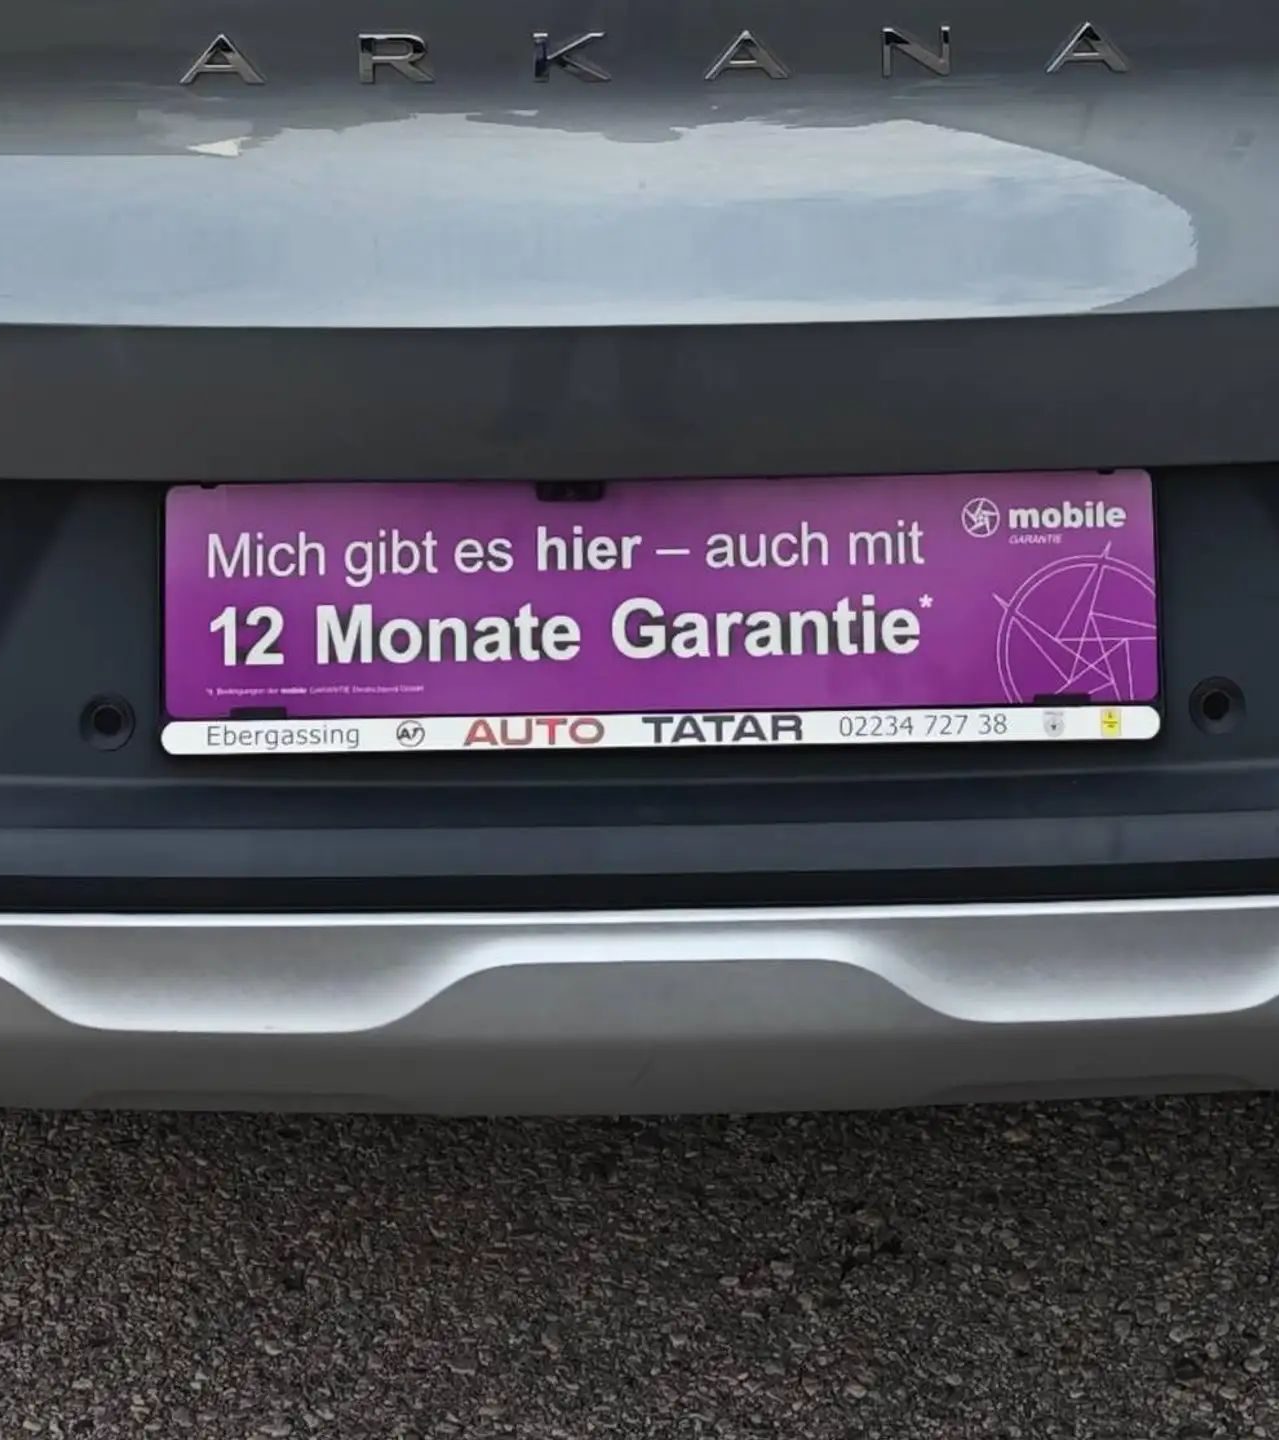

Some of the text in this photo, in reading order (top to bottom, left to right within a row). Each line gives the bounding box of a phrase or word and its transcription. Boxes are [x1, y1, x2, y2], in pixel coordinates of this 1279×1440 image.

[179, 21, 1130, 85] ARKANA
[1008, 500, 1128, 530] mobile
[1008, 533, 1064, 545] GARANTIE
[206, 530, 327, 579] Mich
[344, 528, 440, 588] gibt
[453, 536, 515, 574] es
[535, 524, 644, 572] hier
[705, 521, 830, 569] auch
[848, 519, 926, 565] mit
[209, 605, 285, 667] 12
[315, 601, 582, 665] Monate
[206, 723, 361, 750] Ebergassing
[462, 716, 606, 747] AUTO
[641, 714, 804, 744] TATAR
[838, 715, 914, 738] 02234
[923, 714, 969, 736] 727
[977, 713, 1009, 735] 38
